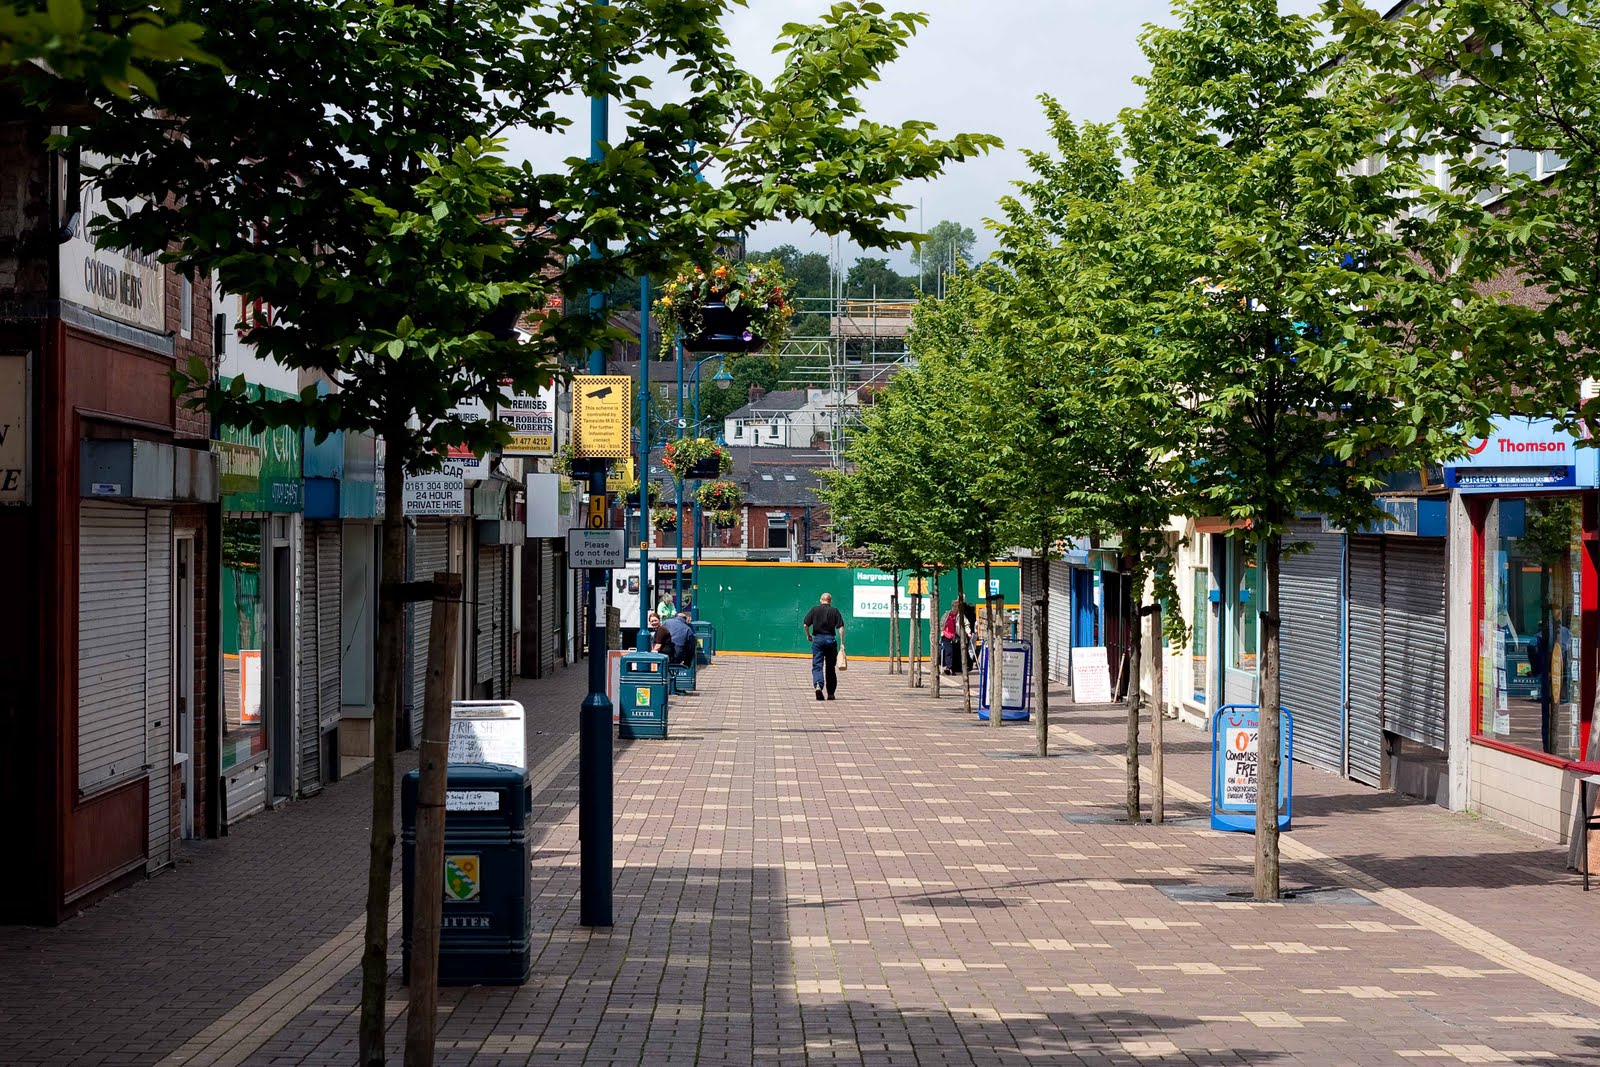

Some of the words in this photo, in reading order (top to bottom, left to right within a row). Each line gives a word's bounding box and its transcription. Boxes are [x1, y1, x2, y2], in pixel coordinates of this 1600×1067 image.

[84, 256, 117, 301] COOKED
[119, 270, 143, 310] MEATS
[512, 400, 547, 410] REMISES
[516, 416, 553, 424] ROBERTS
[516, 424, 553, 432] ROBERTS
[532, 438, 548, 446] 4212
[1497, 438, 1566, 453] Thomson
[405, 482, 425, 491] 0161
[426, 482, 442, 491] 304
[443, 482, 464, 491] 8000
[416, 491, 428, 500] 24
[429, 491, 453, 500] HOUR
[407, 500, 441, 509] PRIVATE
[443, 500, 462, 509] HIRE
[584, 541, 610, 549] Please
[574, 549, 585, 557] do
[587, 549, 601, 557] not
[603, 549, 620, 557] feed
[860, 602, 889, 610] 01204
[1225, 749, 1259, 762] COMMISS
[1236, 762, 1258, 777] FRE
